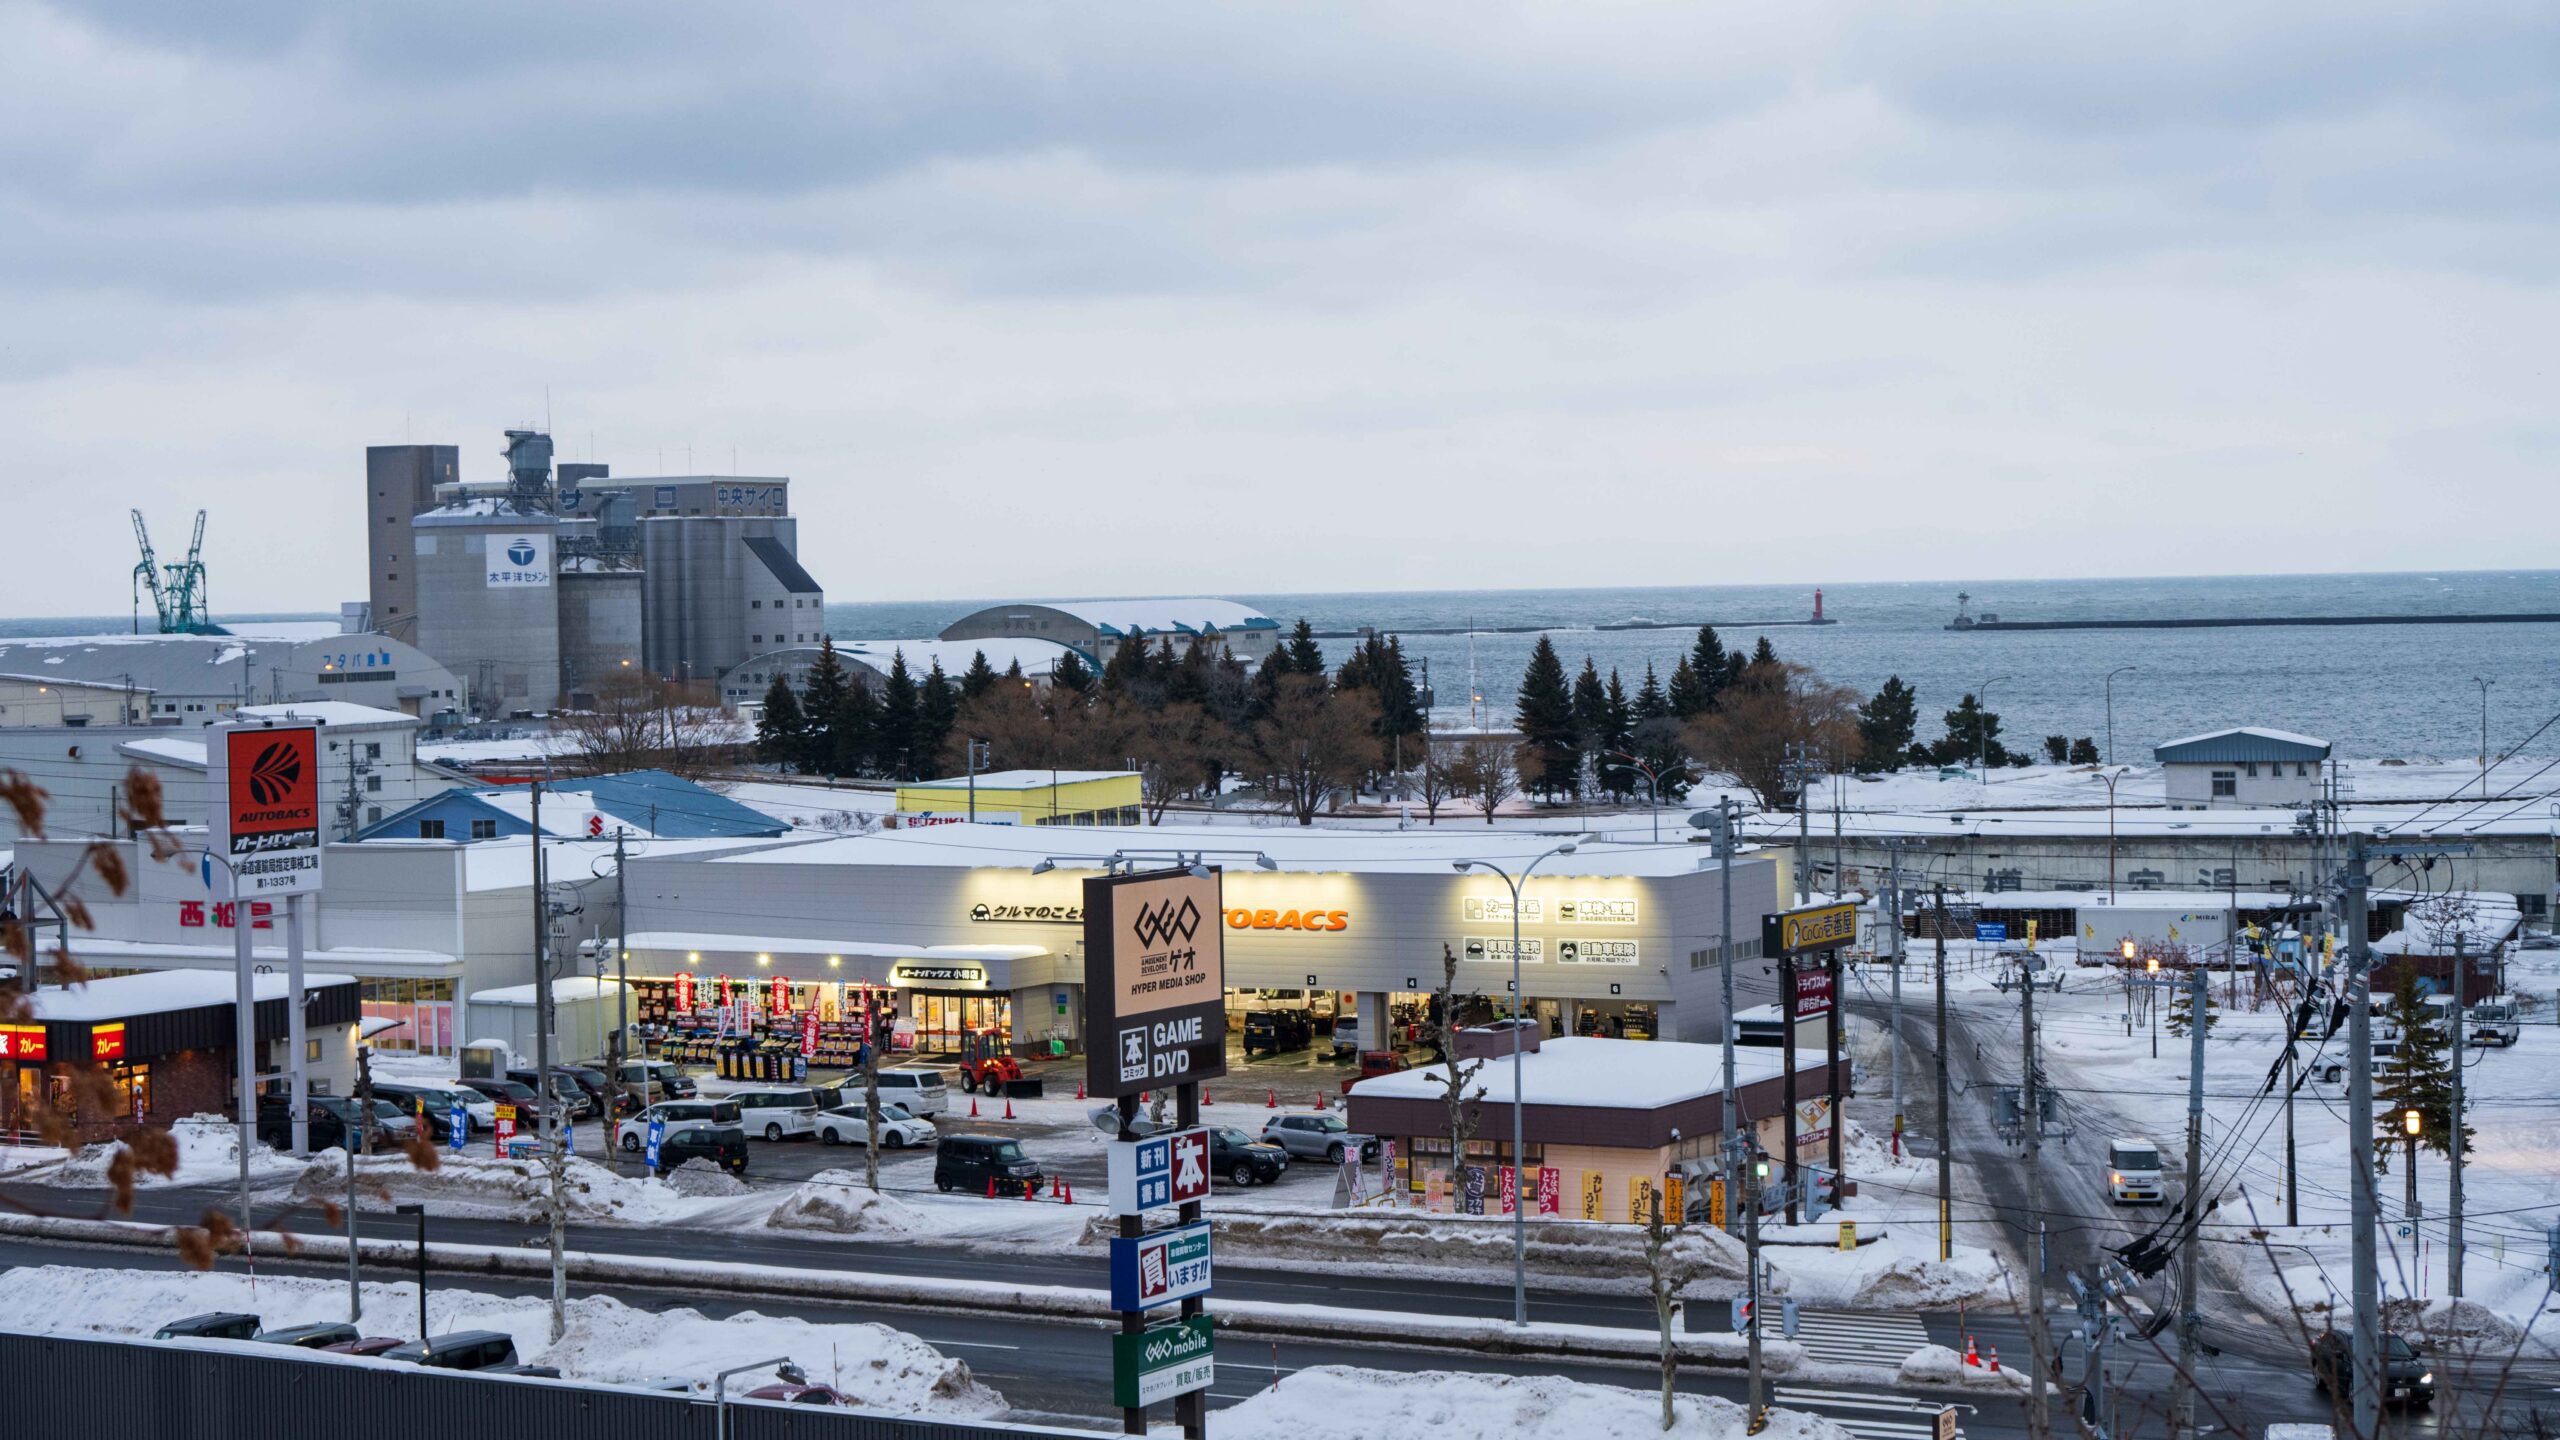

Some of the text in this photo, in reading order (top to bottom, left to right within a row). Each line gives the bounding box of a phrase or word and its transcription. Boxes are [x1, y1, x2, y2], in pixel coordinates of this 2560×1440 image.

[717, 487, 784, 507] 中央サイロ
[489, 571, 549, 583] 太平洋セメント
[239, 808, 311, 823] AUTOBACS
[1133, 895, 1202, 950] GEO
[1802, 910, 1852, 942] CoCo壱番屋
[1169, 946, 1196, 973] ゲオ
[1581, 942, 1636, 956] 自動車保険
[900, 969, 979, 980] オートバックス 小樽店
[1141, 963, 1168, 974] DEVELOPER
[1131, 972, 1206, 996] HYPER MEDIA SHOP
[1797, 976, 1831, 992] ドライブスルー
[1153, 1017, 1202, 1047] GAME
[20, 1037, 45, 1054] カレー
[97, 1038, 120, 1055] カレー
[1125, 1033, 1143, 1064] 本
[1124, 1066, 1145, 1079] コミック
[1153, 1049, 1190, 1078] DVD
[1140, 1145, 1165, 1170] 新刊
[1176, 1139, 1205, 1194] 本
[1141, 1180, 1166, 1204] 書籍
[1503, 1171, 1514, 1211] とんかつ
[1540, 1171, 1551, 1211] とんかつ
[1593, 1175, 1603, 1203] カレー
[1640, 1181, 1650, 1209] カレー
[2402, 1227, 2412, 1239] P
[1142, 1246, 1166, 1296] 買
[1145, 1333, 1207, 1363] GEO mobile
